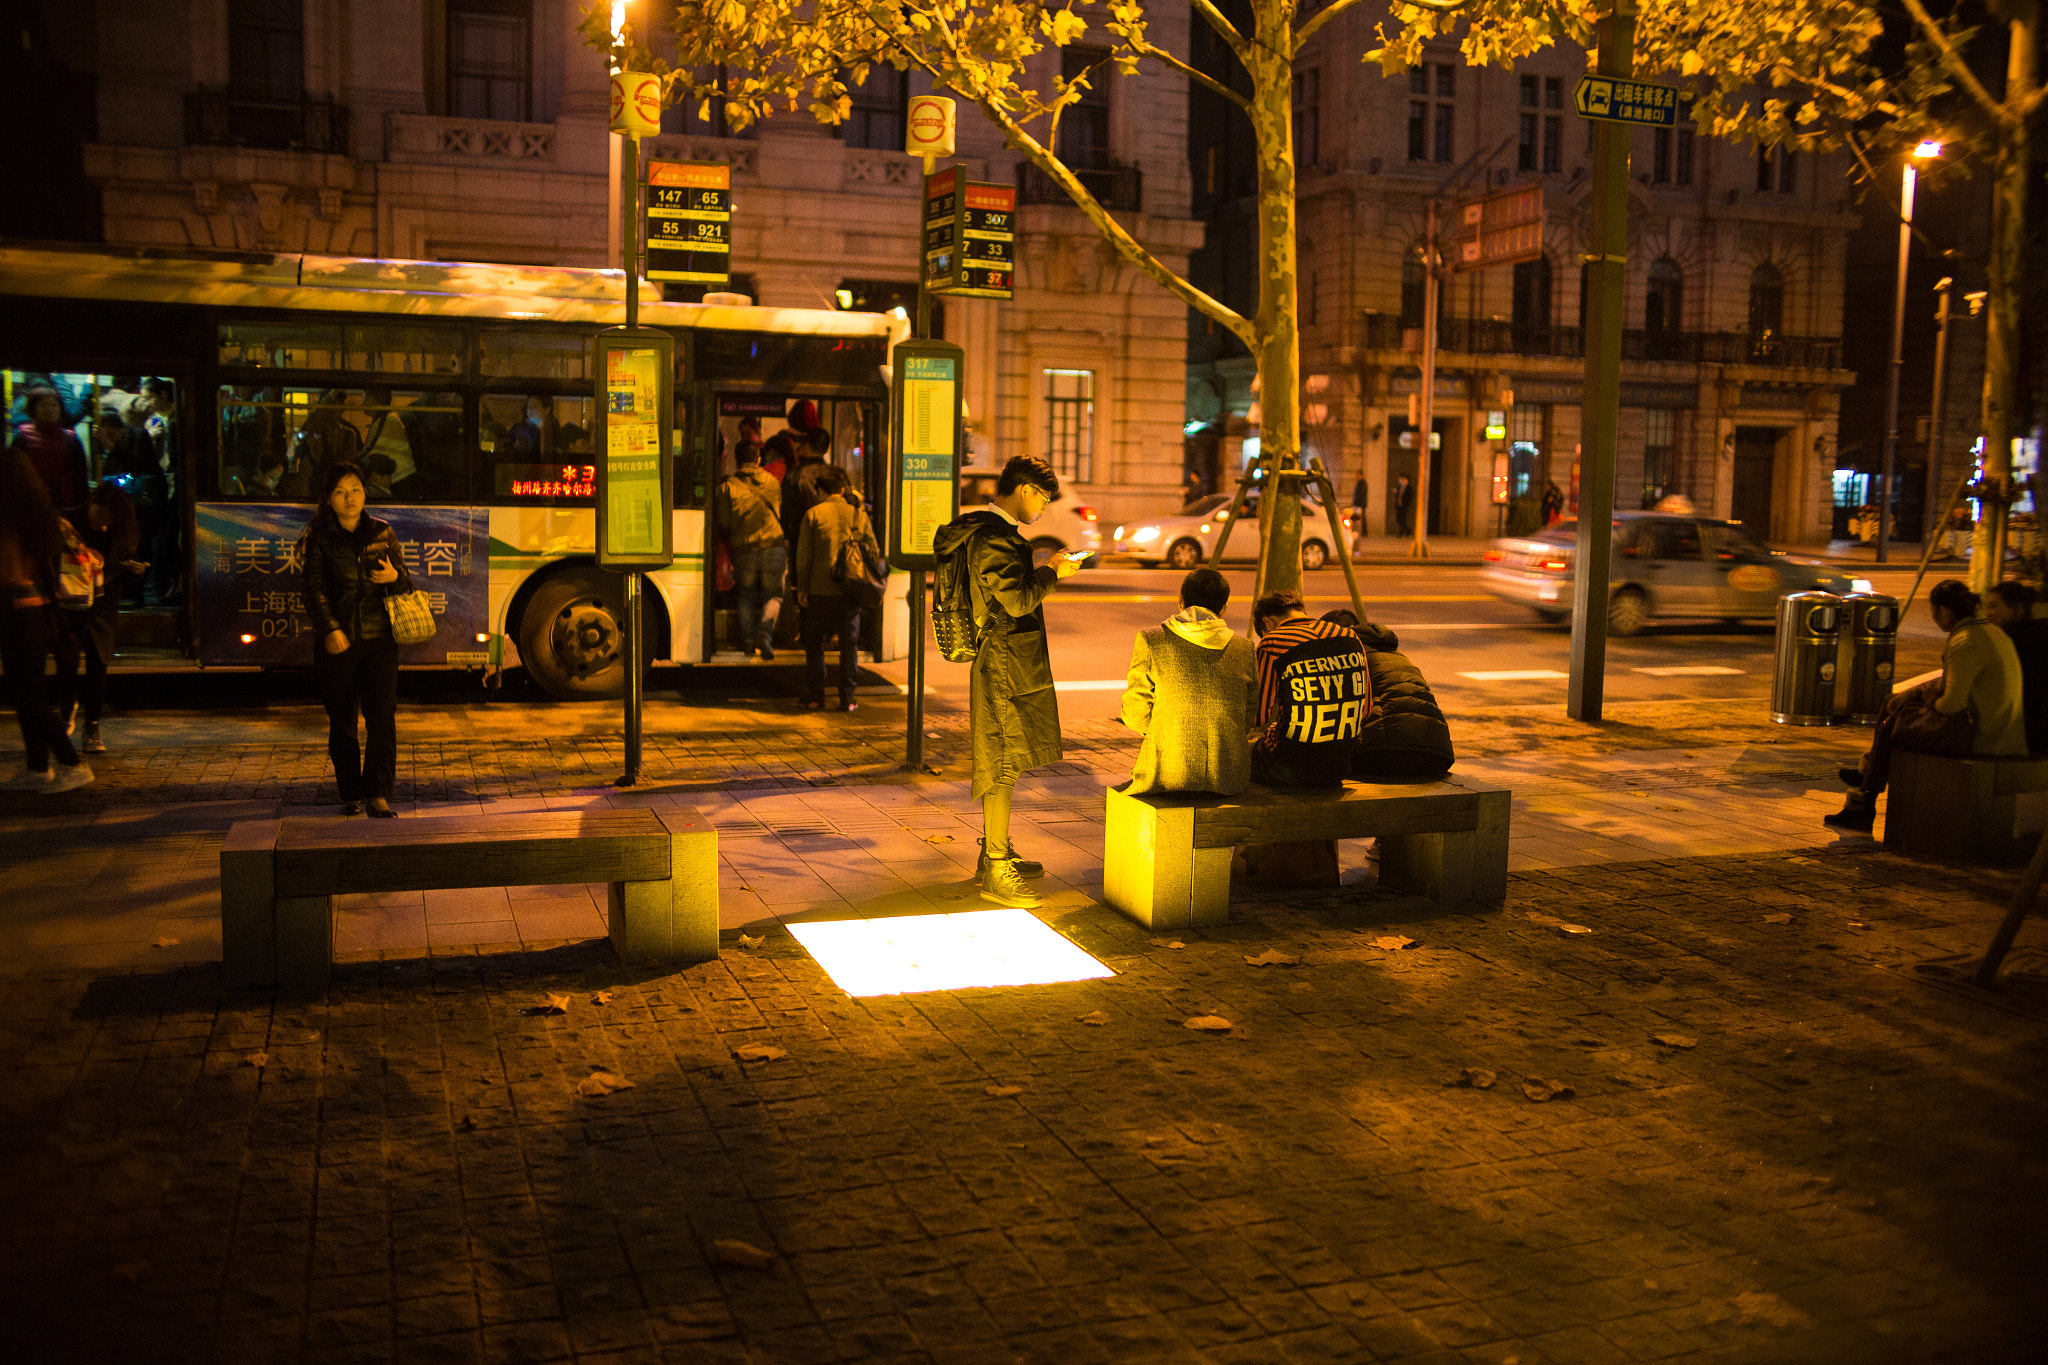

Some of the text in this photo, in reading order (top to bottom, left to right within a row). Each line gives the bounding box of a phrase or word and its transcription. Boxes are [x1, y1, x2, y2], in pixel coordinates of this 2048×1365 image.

[658, 189, 682, 203] 147
[702, 192, 719, 205] 65
[985, 213, 1007, 225] 307
[662, 221, 679, 235] 55
[698, 224, 721, 237] 921
[987, 243, 1003, 255] 33
[987, 272, 1002, 284] 37
[908, 358, 928, 369] 317
[906, 458, 928, 470] 330
[1290, 674, 1344, 702] SEYY
